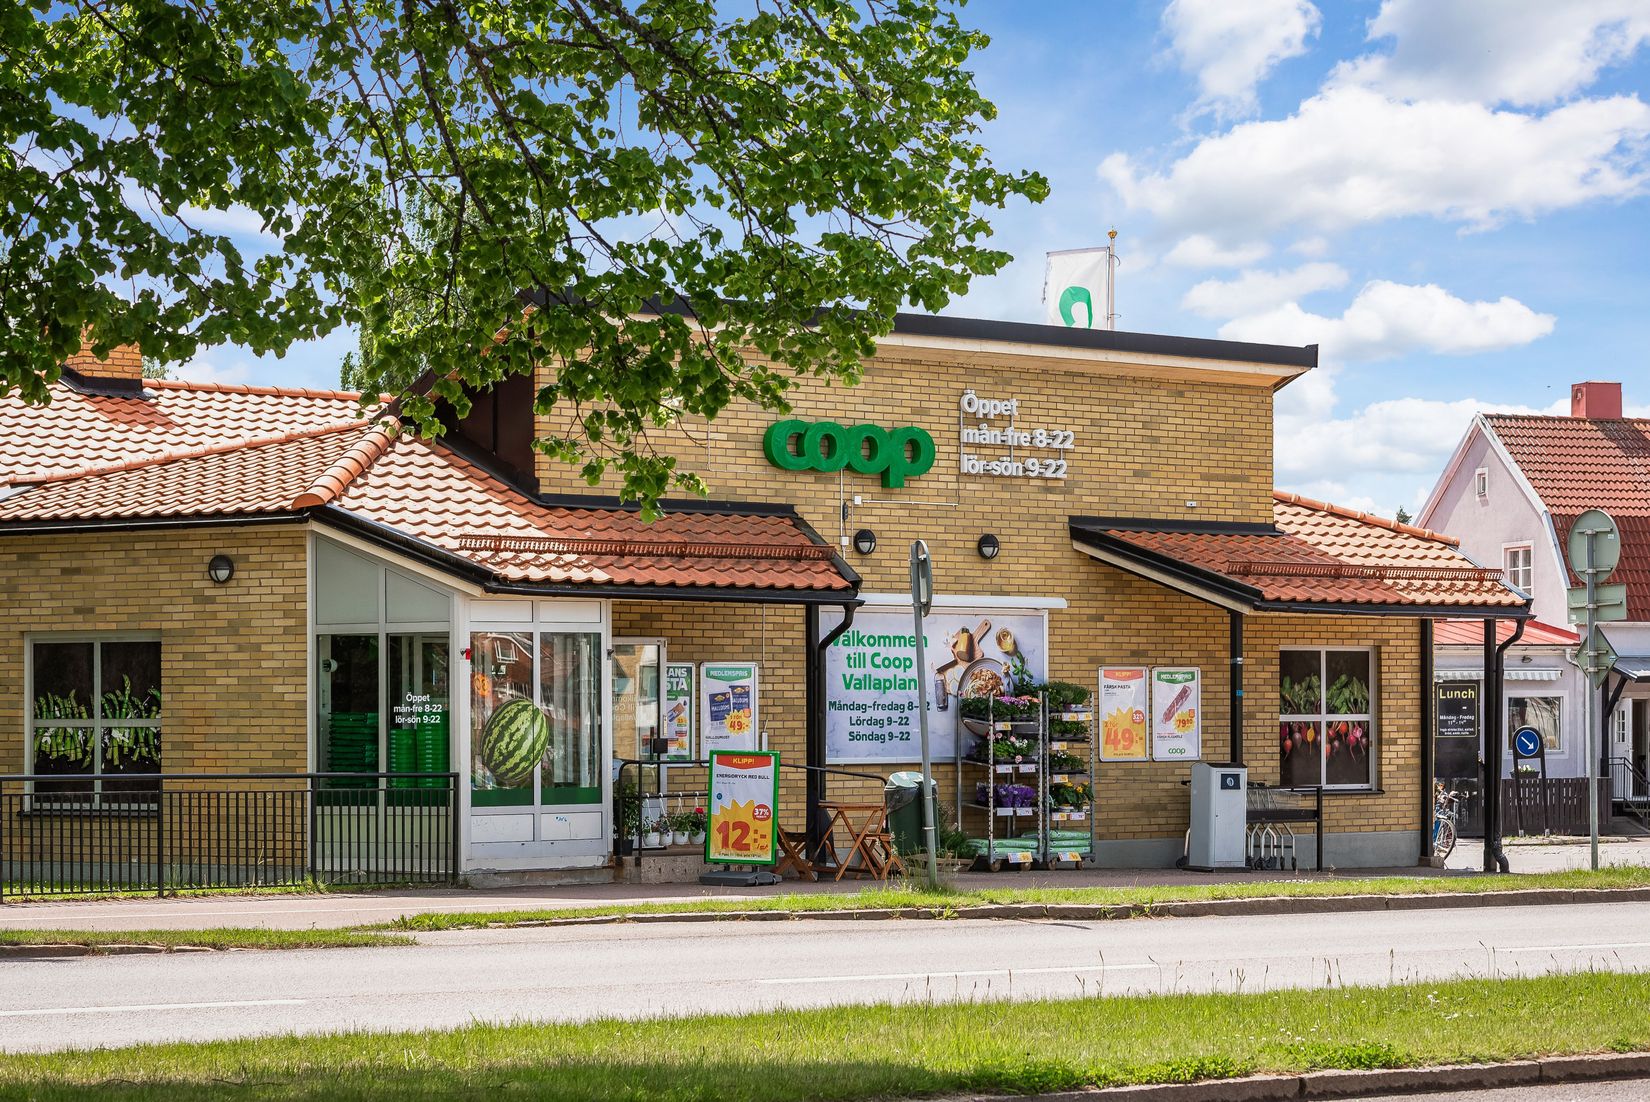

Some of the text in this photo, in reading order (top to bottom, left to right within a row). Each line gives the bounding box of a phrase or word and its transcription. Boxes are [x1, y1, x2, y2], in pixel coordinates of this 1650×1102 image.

[960, 389, 1018, 418] Öppet
[960, 423, 1075, 448] mån-fre 8-22
[763, 419, 936, 488] coop
[960, 454, 1068, 478] lör-sön 9-22
[846, 652, 914, 672] till Coop
[842, 674, 918, 694] Vallaplan
[406, 692, 430, 703] Öppet
[1440, 688, 1475, 698] Lunch
[394, 704, 442, 712] mån-fre 8-22
[828, 700, 930, 713] Måndag-fredag 8-2
[396, 715, 440, 724] lör-sön 9-22
[850, 716, 910, 728] Lördag 9-22
[848, 731, 910, 743] Söndag 9-22
